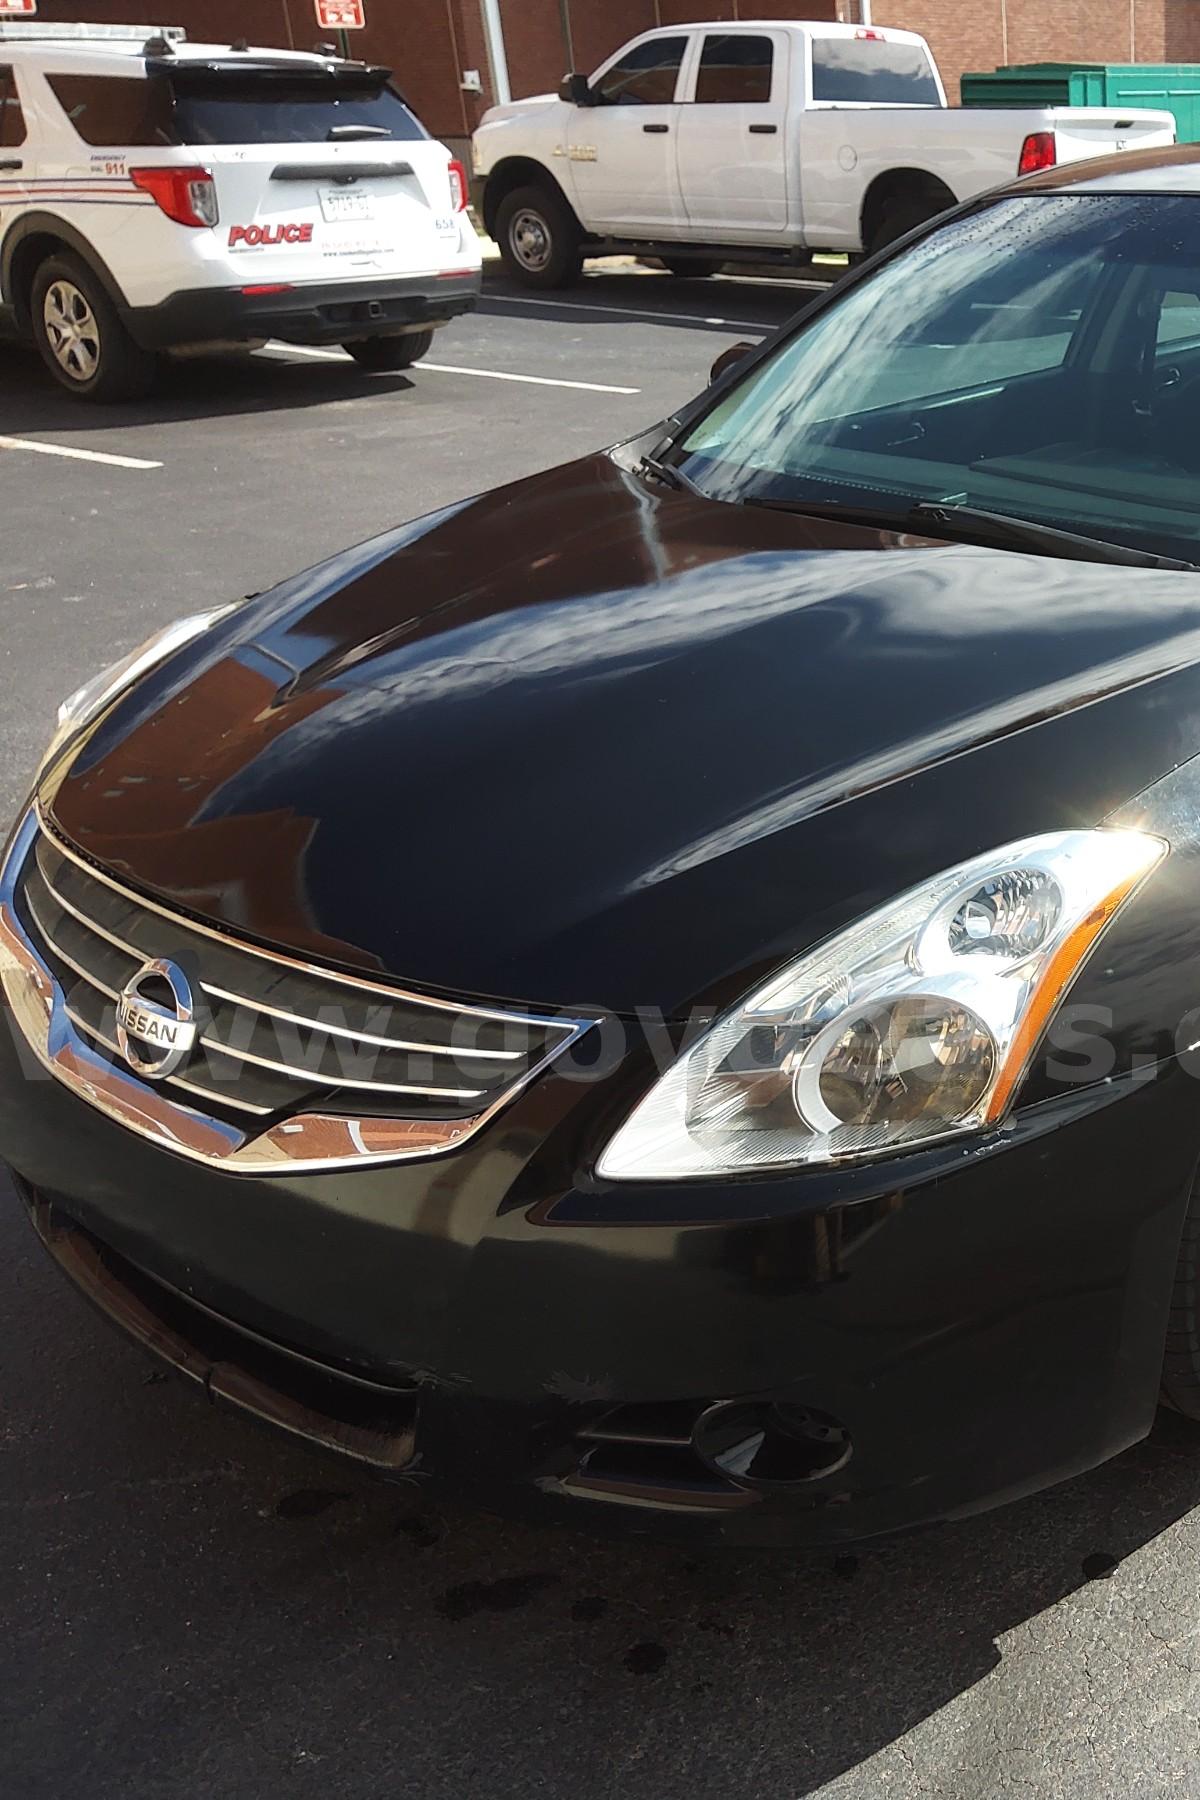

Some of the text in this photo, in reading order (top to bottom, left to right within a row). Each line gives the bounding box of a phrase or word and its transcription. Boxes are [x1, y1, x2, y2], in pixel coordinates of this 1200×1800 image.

[105, 162, 125, 175] 911
[228, 223, 314, 247] POLICE
[119, 1000, 178, 1043] NISSAN
